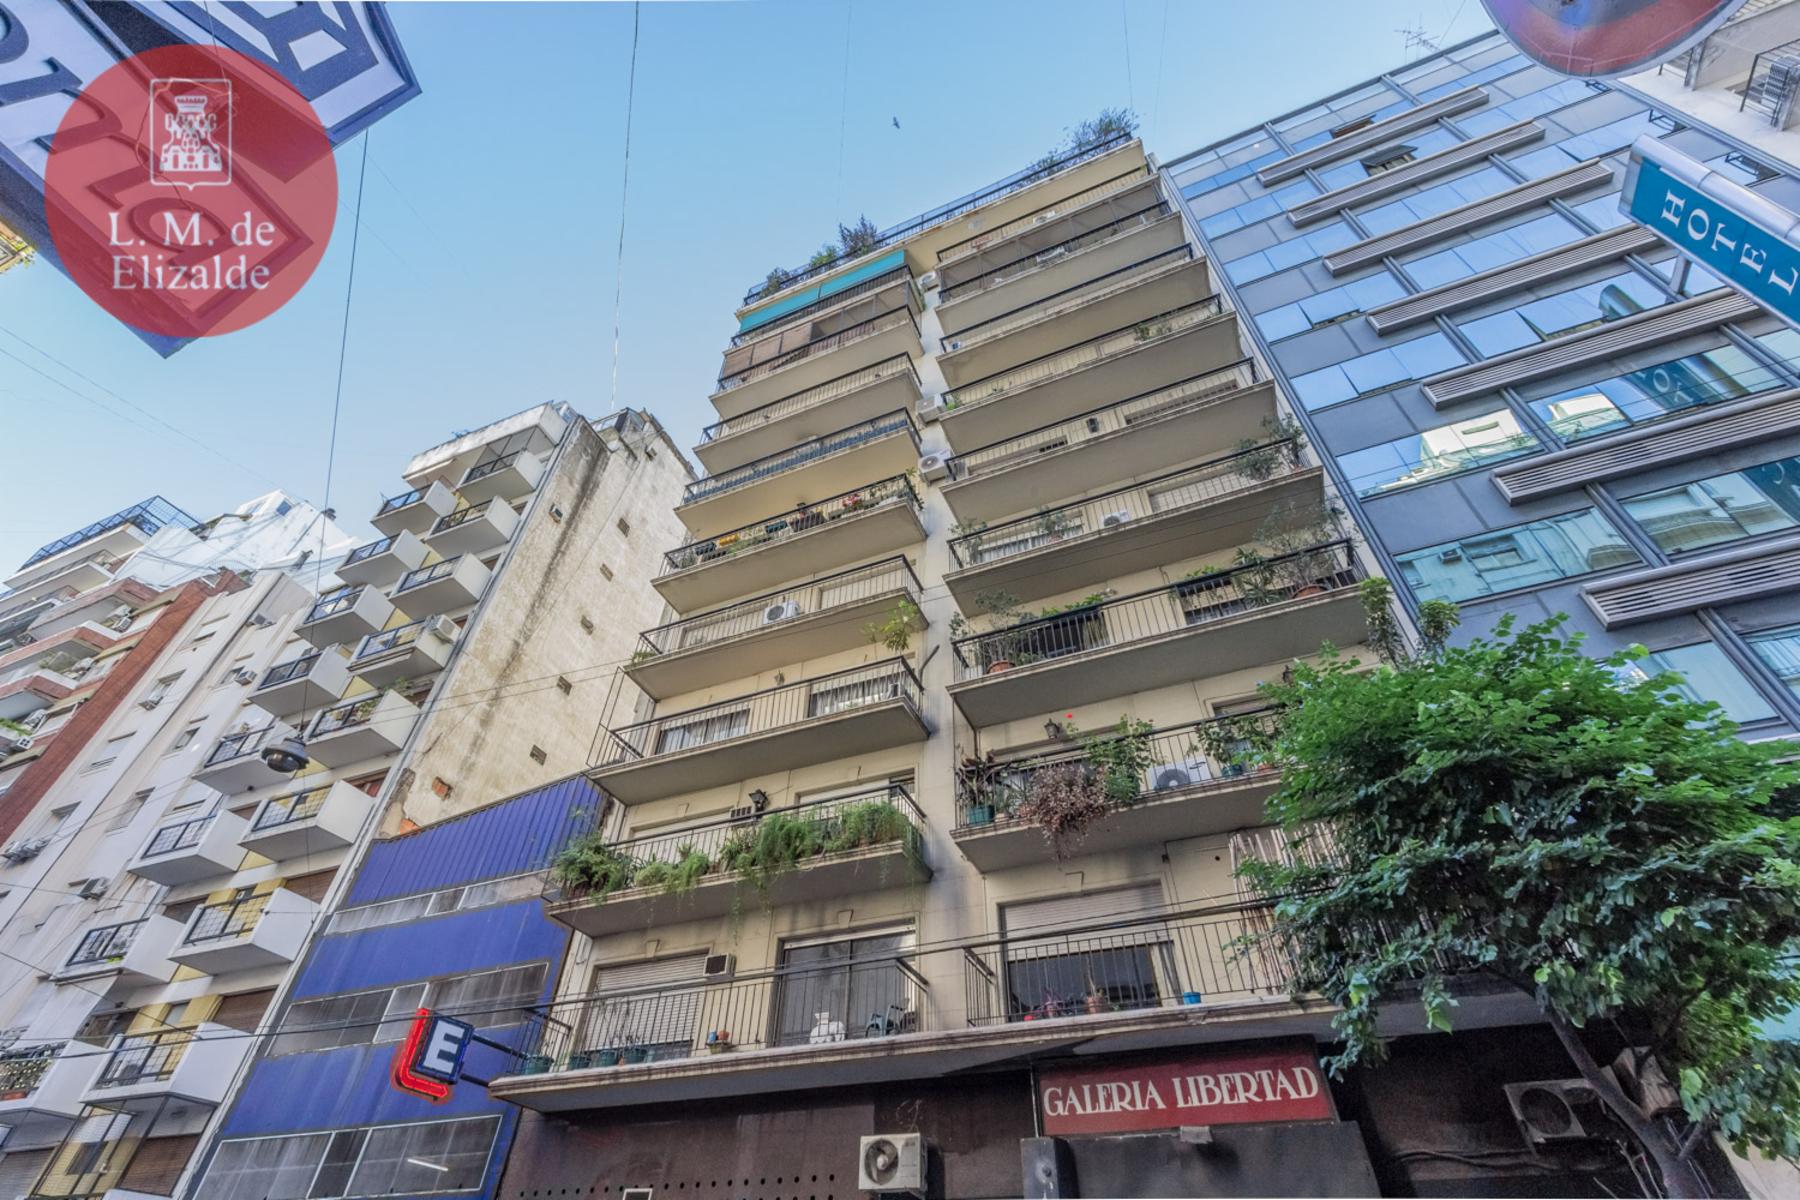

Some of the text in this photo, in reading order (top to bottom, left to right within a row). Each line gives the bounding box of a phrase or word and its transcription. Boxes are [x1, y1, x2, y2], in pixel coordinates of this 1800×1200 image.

[1661, 189, 1799, 296] HOTEL
[1043, 1066, 1319, 1116] GALERIA LIBERTAD
